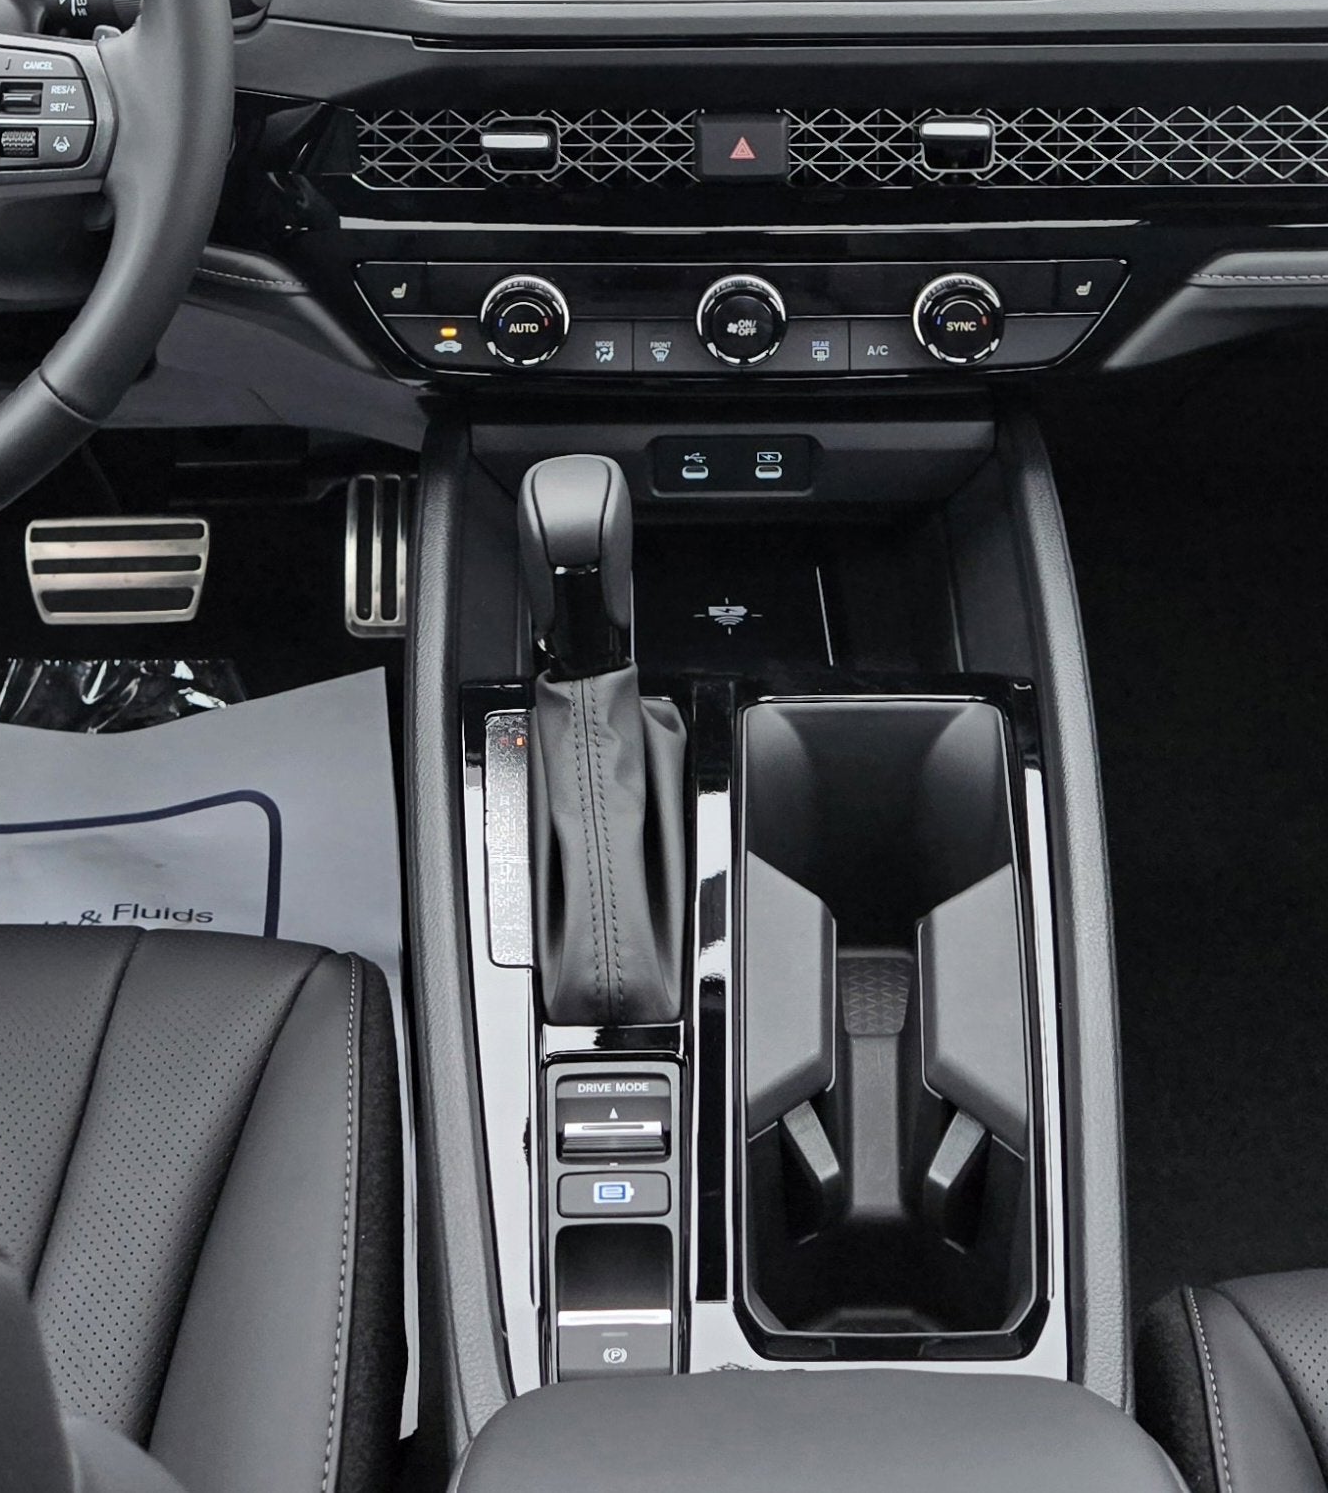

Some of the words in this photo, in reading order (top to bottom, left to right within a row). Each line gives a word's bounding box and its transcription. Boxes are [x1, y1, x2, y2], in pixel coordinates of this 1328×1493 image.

[23, 60, 54, 71] CANCEL
[508, 323, 539, 334] AUTO
[737, 327, 757, 337] OFF
[945, 321, 977, 333] SYNC
[595, 340, 614, 348] MODE
[650, 341, 672, 350] FRONT
[866, 345, 889, 356] A/C
[112, 901, 215, 926] Fluids
[577, 1082, 612, 1094] DRIVE
[615, 1081, 650, 1093] MODE
